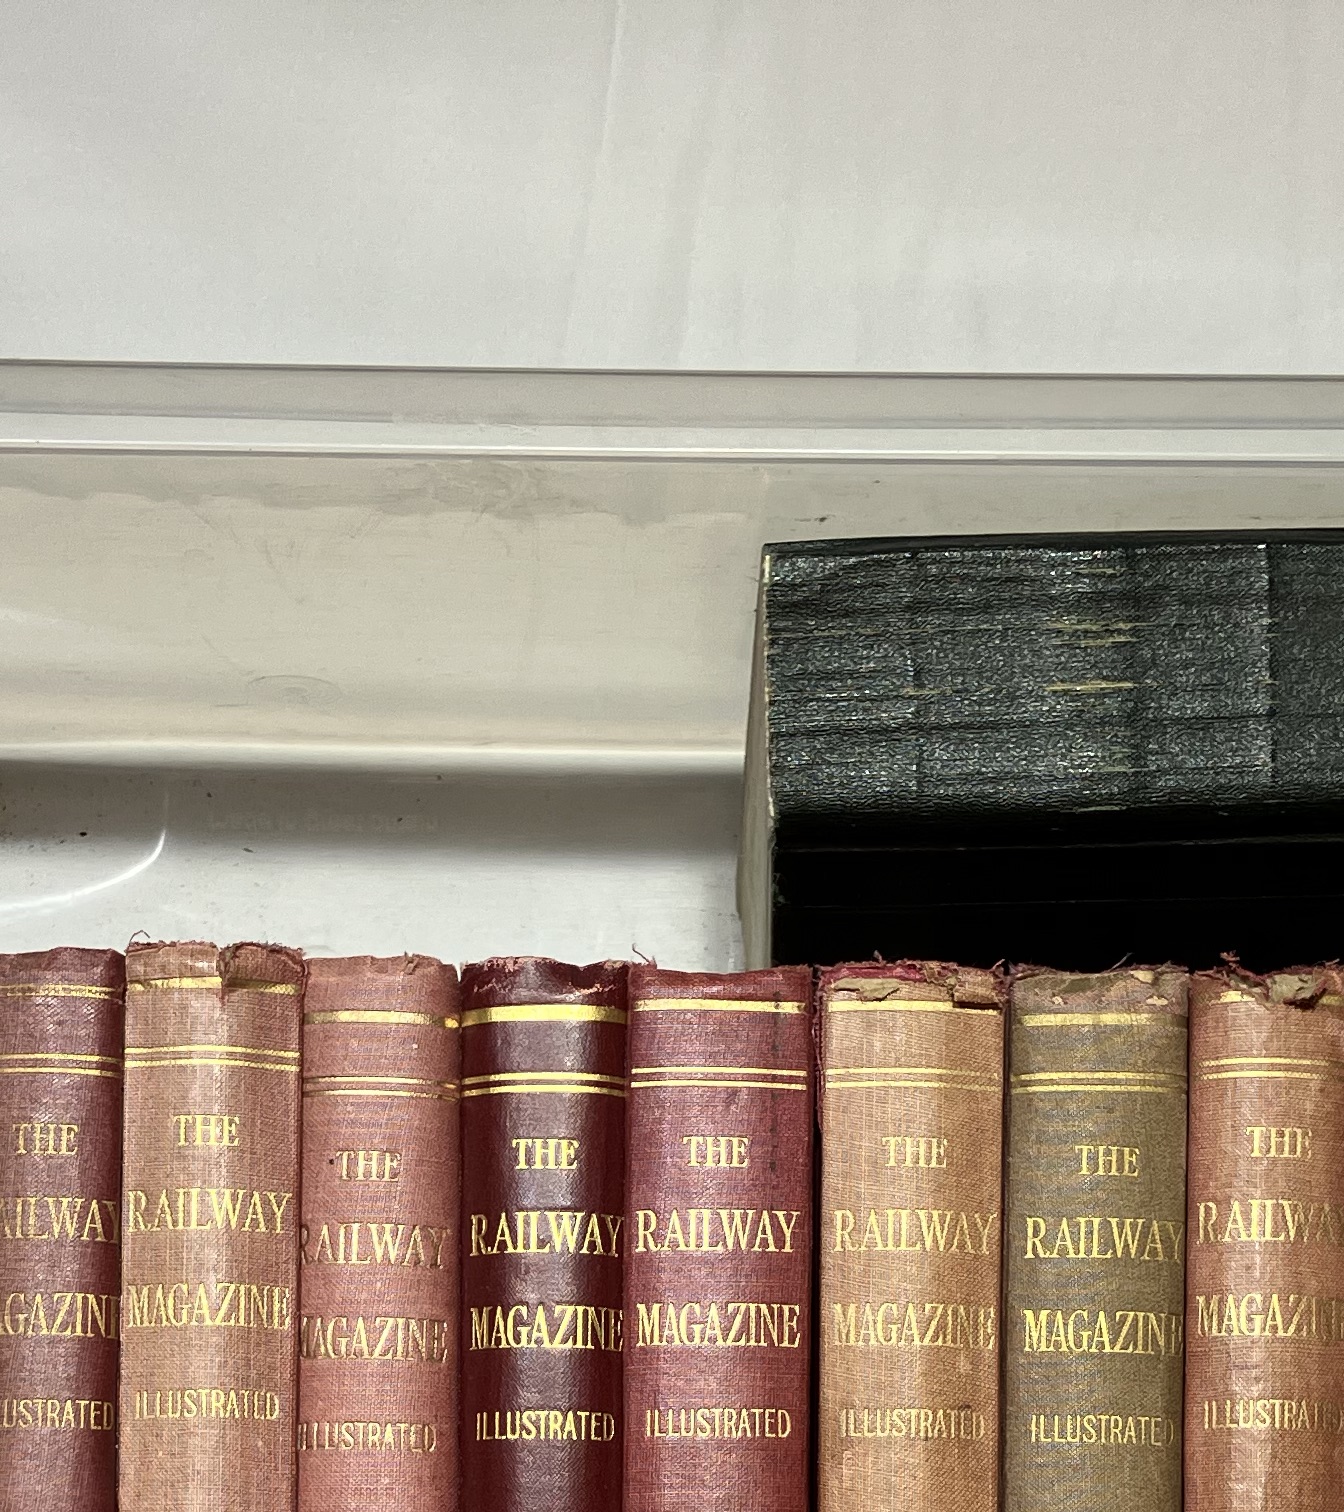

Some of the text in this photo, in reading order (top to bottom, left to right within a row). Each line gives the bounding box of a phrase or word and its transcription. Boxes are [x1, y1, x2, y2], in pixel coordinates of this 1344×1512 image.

[13, 1123, 80, 1157] THE
[173, 1113, 242, 1148] THE
[1244, 1126, 1313, 1160] THE
[335, 1150, 403, 1183] THE
[512, 1137, 580, 1171] THE
[683, 1135, 751, 1169] THE
[882, 1135, 948, 1169] THE
[1074, 1145, 1141, 1178] THE
[127, 1187, 293, 1235] RAILWAY
[298, 1222, 453, 1270] RAILWAY
[469, 1211, 625, 1259] RAILWAY
[635, 1208, 801, 1254] RAILWAY
[833, 1208, 998, 1257] RAILWAY
[1024, 1216, 1184, 1265] RAILWAY
[127, 1283, 292, 1330] MAGAZINE
[469, 1305, 624, 1352] MAGAZINE
[635, 1302, 801, 1349] MAGAZINE
[833, 1302, 996, 1351] MAGAZINE
[1022, 1309, 1183, 1358] MAGAZINE
[133, 1388, 280, 1421] ILLUSTRATED
[297, 1421, 438, 1454] ILLUSTRATED
[476, 1410, 616, 1443] ILLUSTRATED
[645, 1408, 792, 1440] ILLUSTRATED
[840, 1408, 985, 1441] ILLUSTRATED
[1030, 1414, 1175, 1447] ILLUSTRATED
